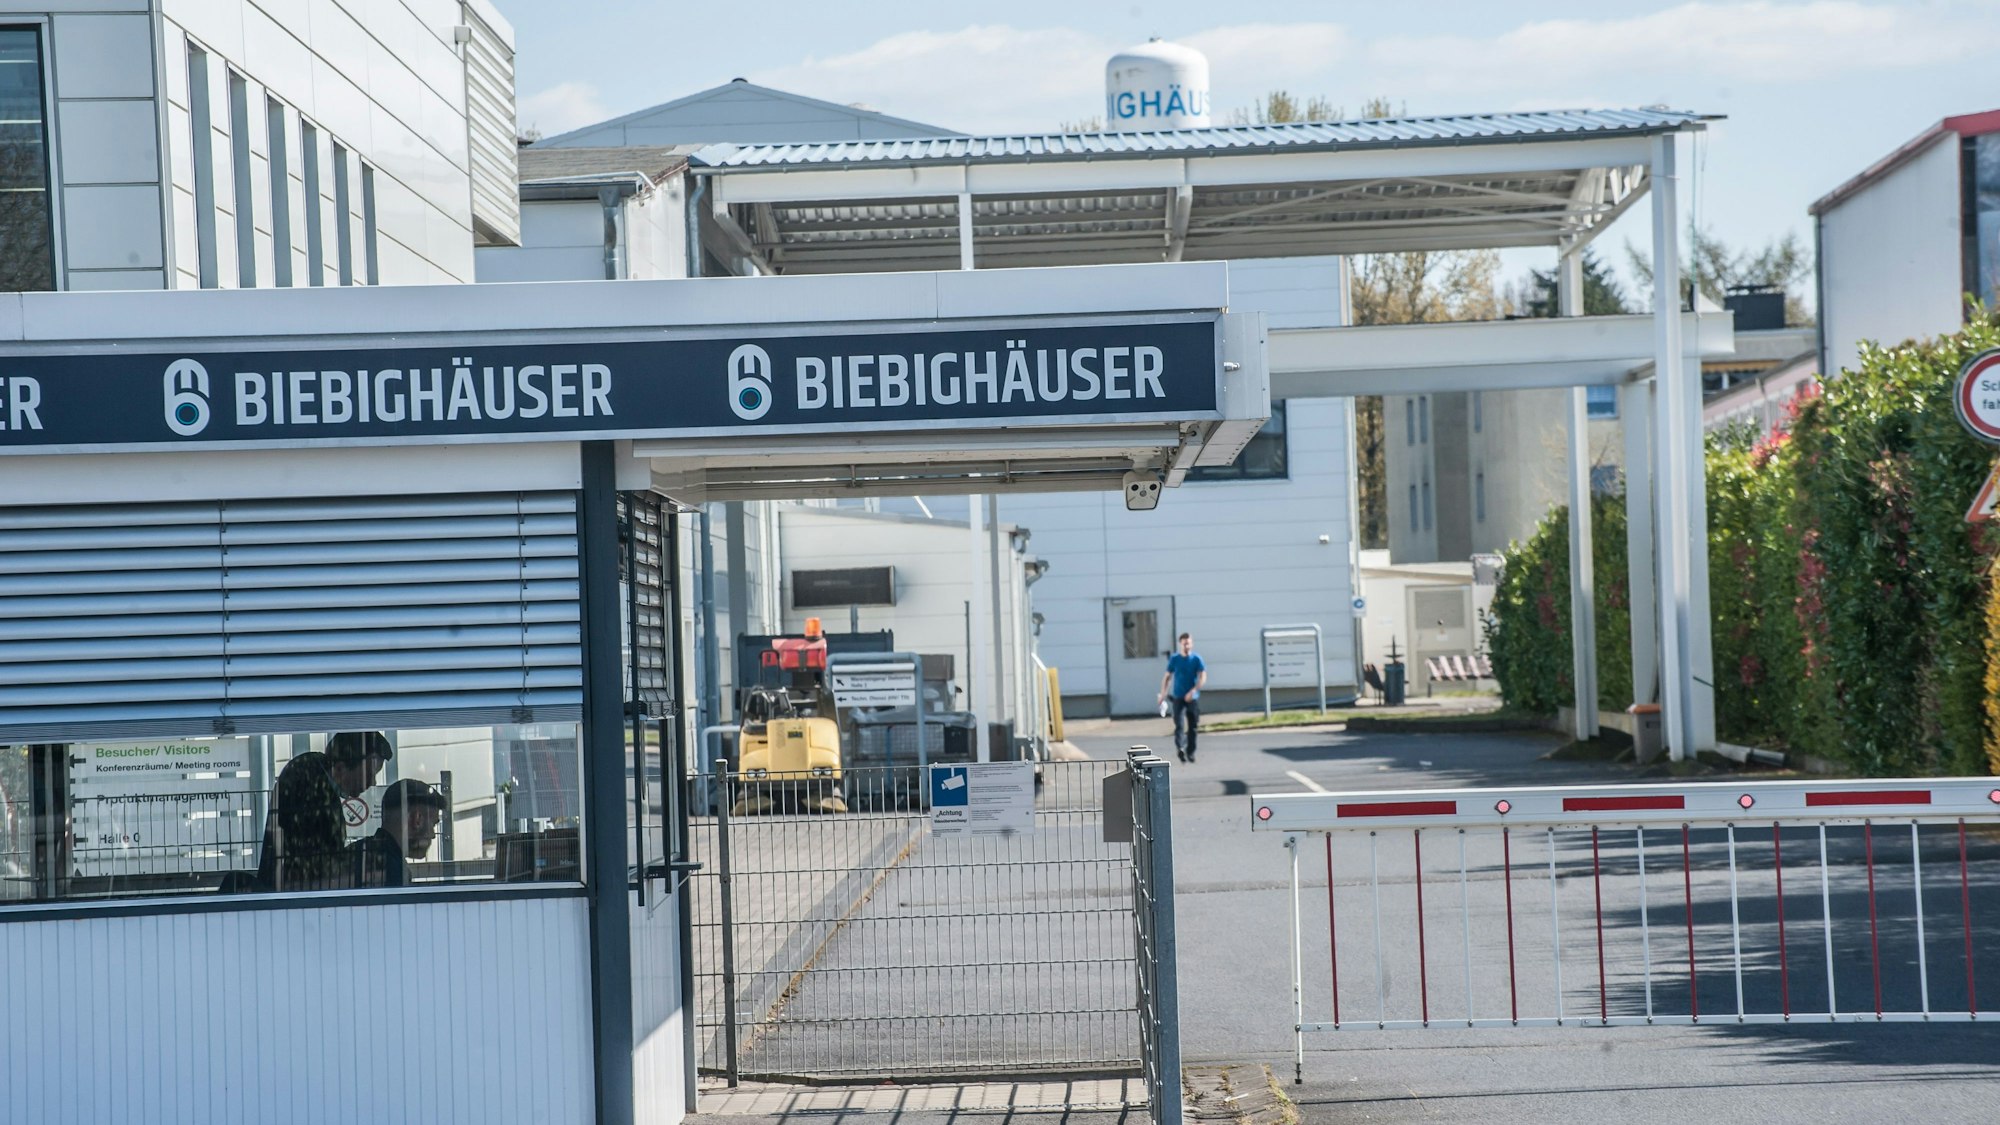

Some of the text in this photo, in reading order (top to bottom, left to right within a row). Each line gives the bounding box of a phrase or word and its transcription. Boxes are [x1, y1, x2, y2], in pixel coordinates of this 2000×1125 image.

[1107, 84, 1209, 120] IGHÄUS
[235, 356, 614, 426] BIEBIGHÄUSER
[796, 339, 1166, 410] BIEBIGHÄUSER
[1982, 380, 2000, 391] Sc
[0, 376, 43, 431] R
[96, 744, 210, 758] Besucher/ Visitors
[96, 760, 240, 773] Konferenzräume/ Meeting rooms
